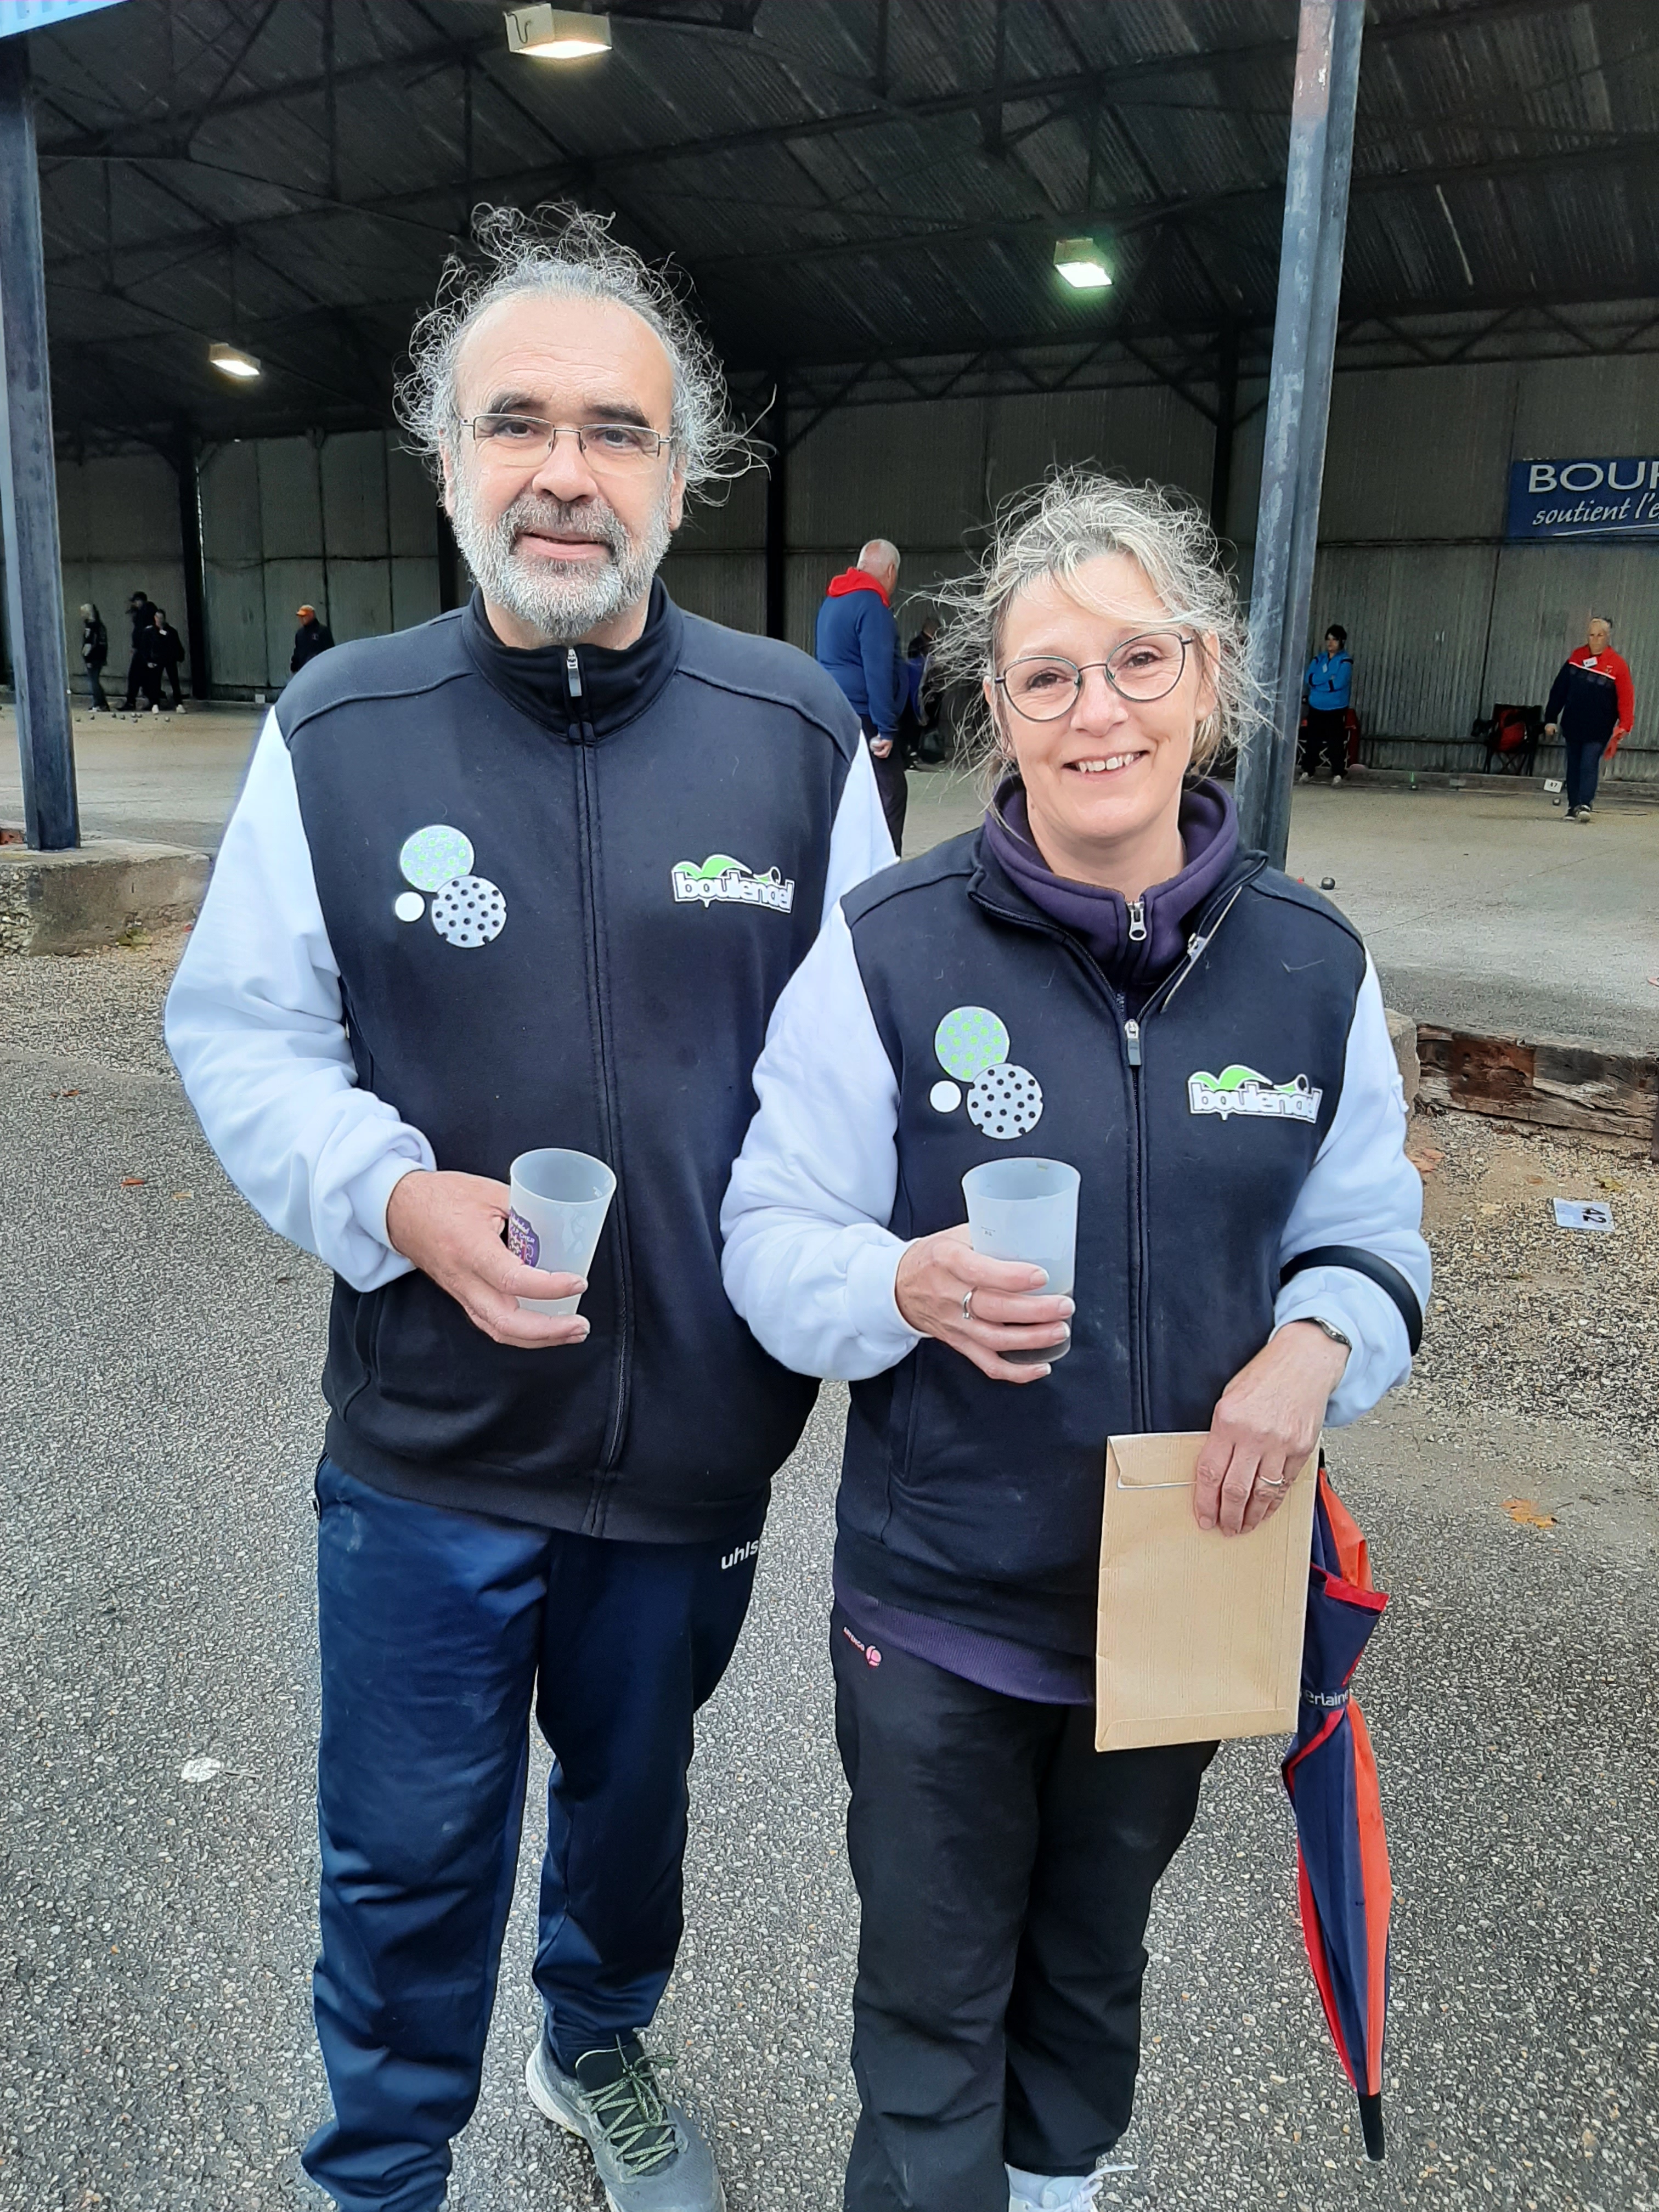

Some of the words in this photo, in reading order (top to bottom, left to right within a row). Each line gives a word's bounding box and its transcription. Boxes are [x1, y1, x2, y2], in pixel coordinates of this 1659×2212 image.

[1532, 497, 1631, 525] soutient
[1635, 493, 1659, 520] l'e
[1581, 1207, 1607, 1223] 42
